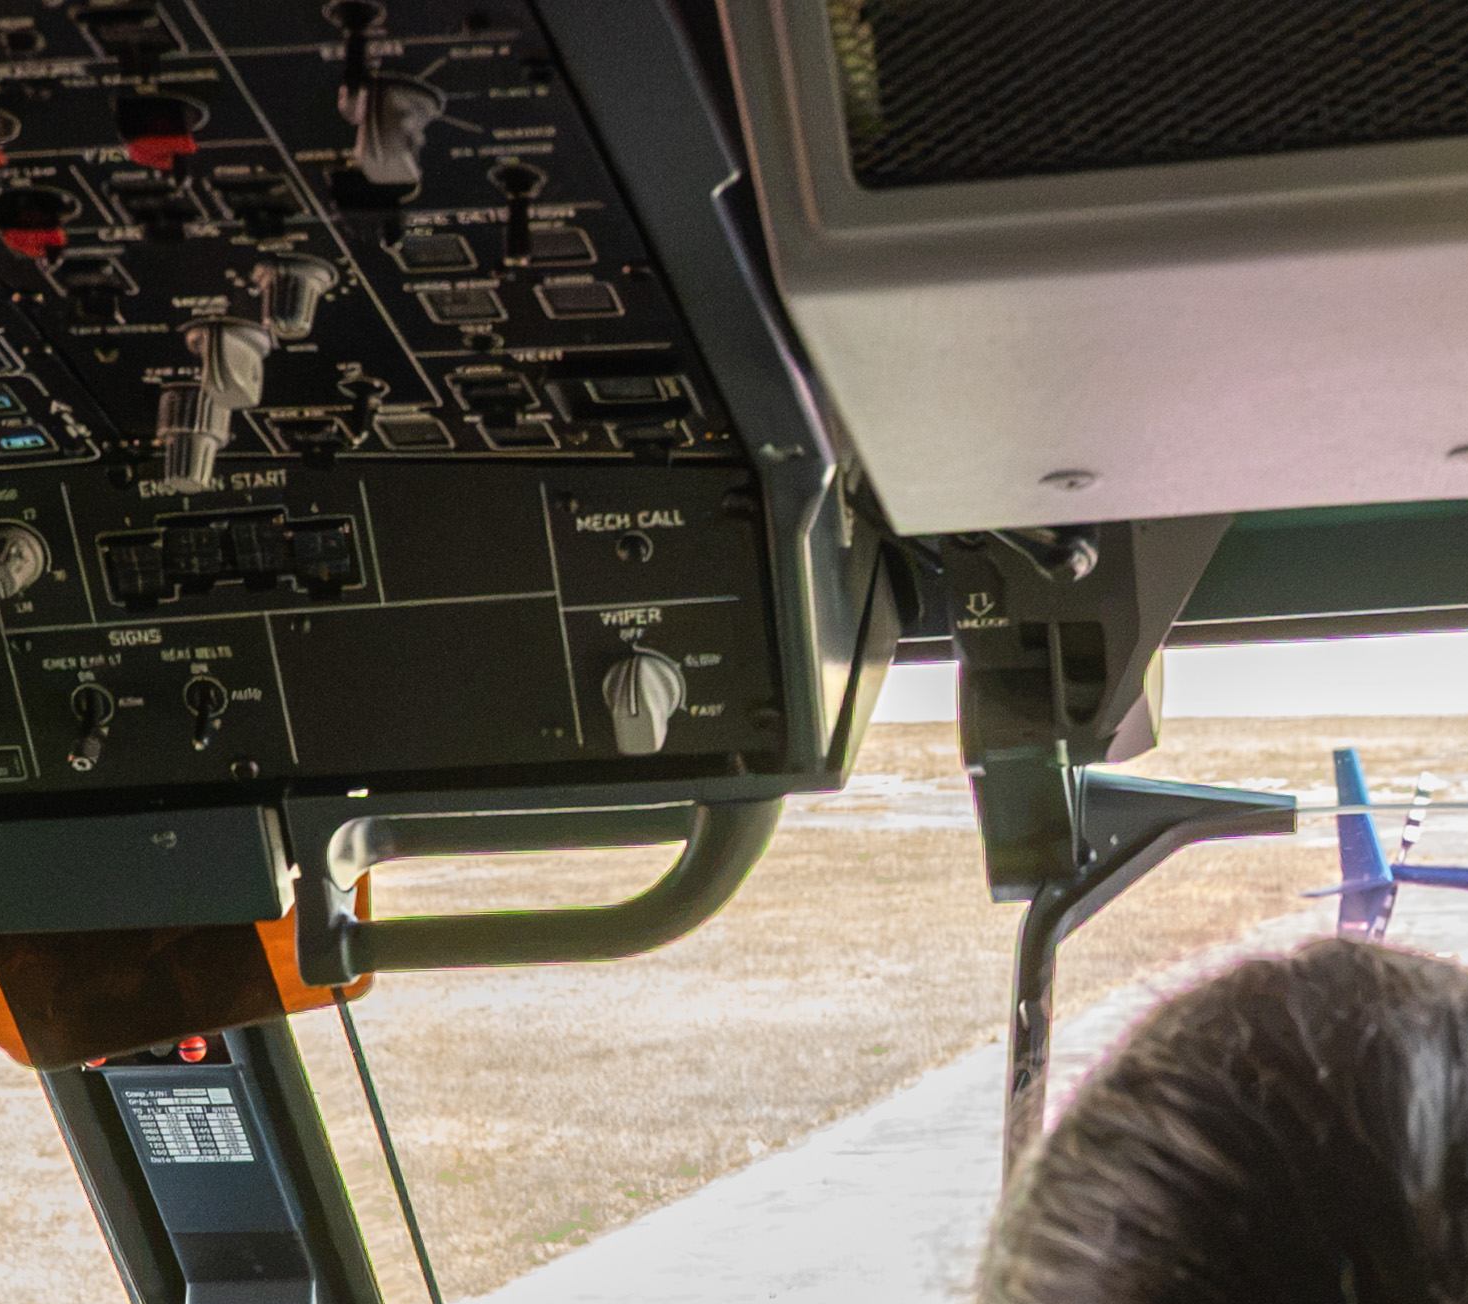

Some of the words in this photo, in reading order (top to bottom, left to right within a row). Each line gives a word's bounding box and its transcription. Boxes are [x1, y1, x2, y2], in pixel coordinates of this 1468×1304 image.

[231, 468, 288, 494] START
[577, 514, 630, 531] MECH
[636, 511, 685, 528] CALL
[602, 610, 661, 625] WIPER
[110, 631, 161, 646] SIGNS
